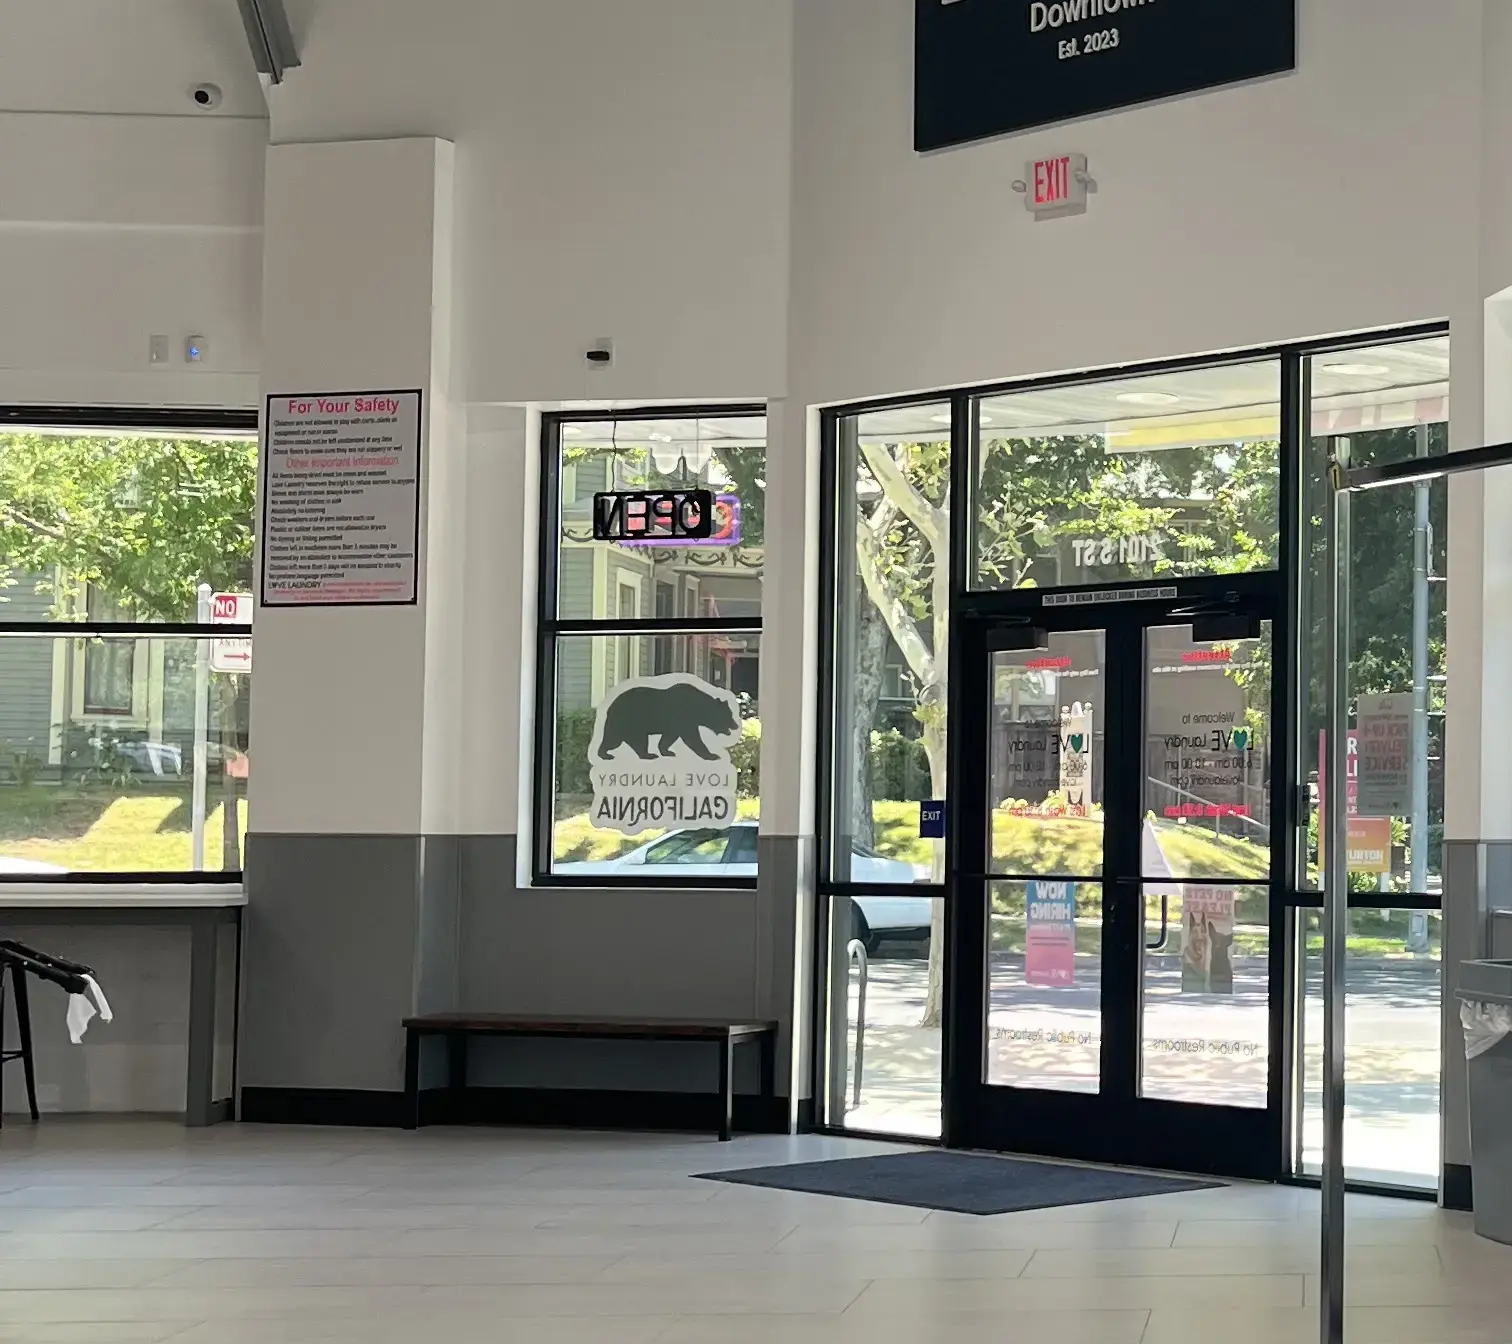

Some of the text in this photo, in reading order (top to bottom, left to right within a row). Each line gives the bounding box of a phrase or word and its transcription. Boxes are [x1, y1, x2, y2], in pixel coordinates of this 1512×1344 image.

[1058, 28, 1120, 59] Est. 2023
[1034, 156, 1070, 203] EXIT
[288, 396, 399, 414] For Your Safety
[215, 600, 236, 615] NO
[922, 810, 941, 822] EXIT
